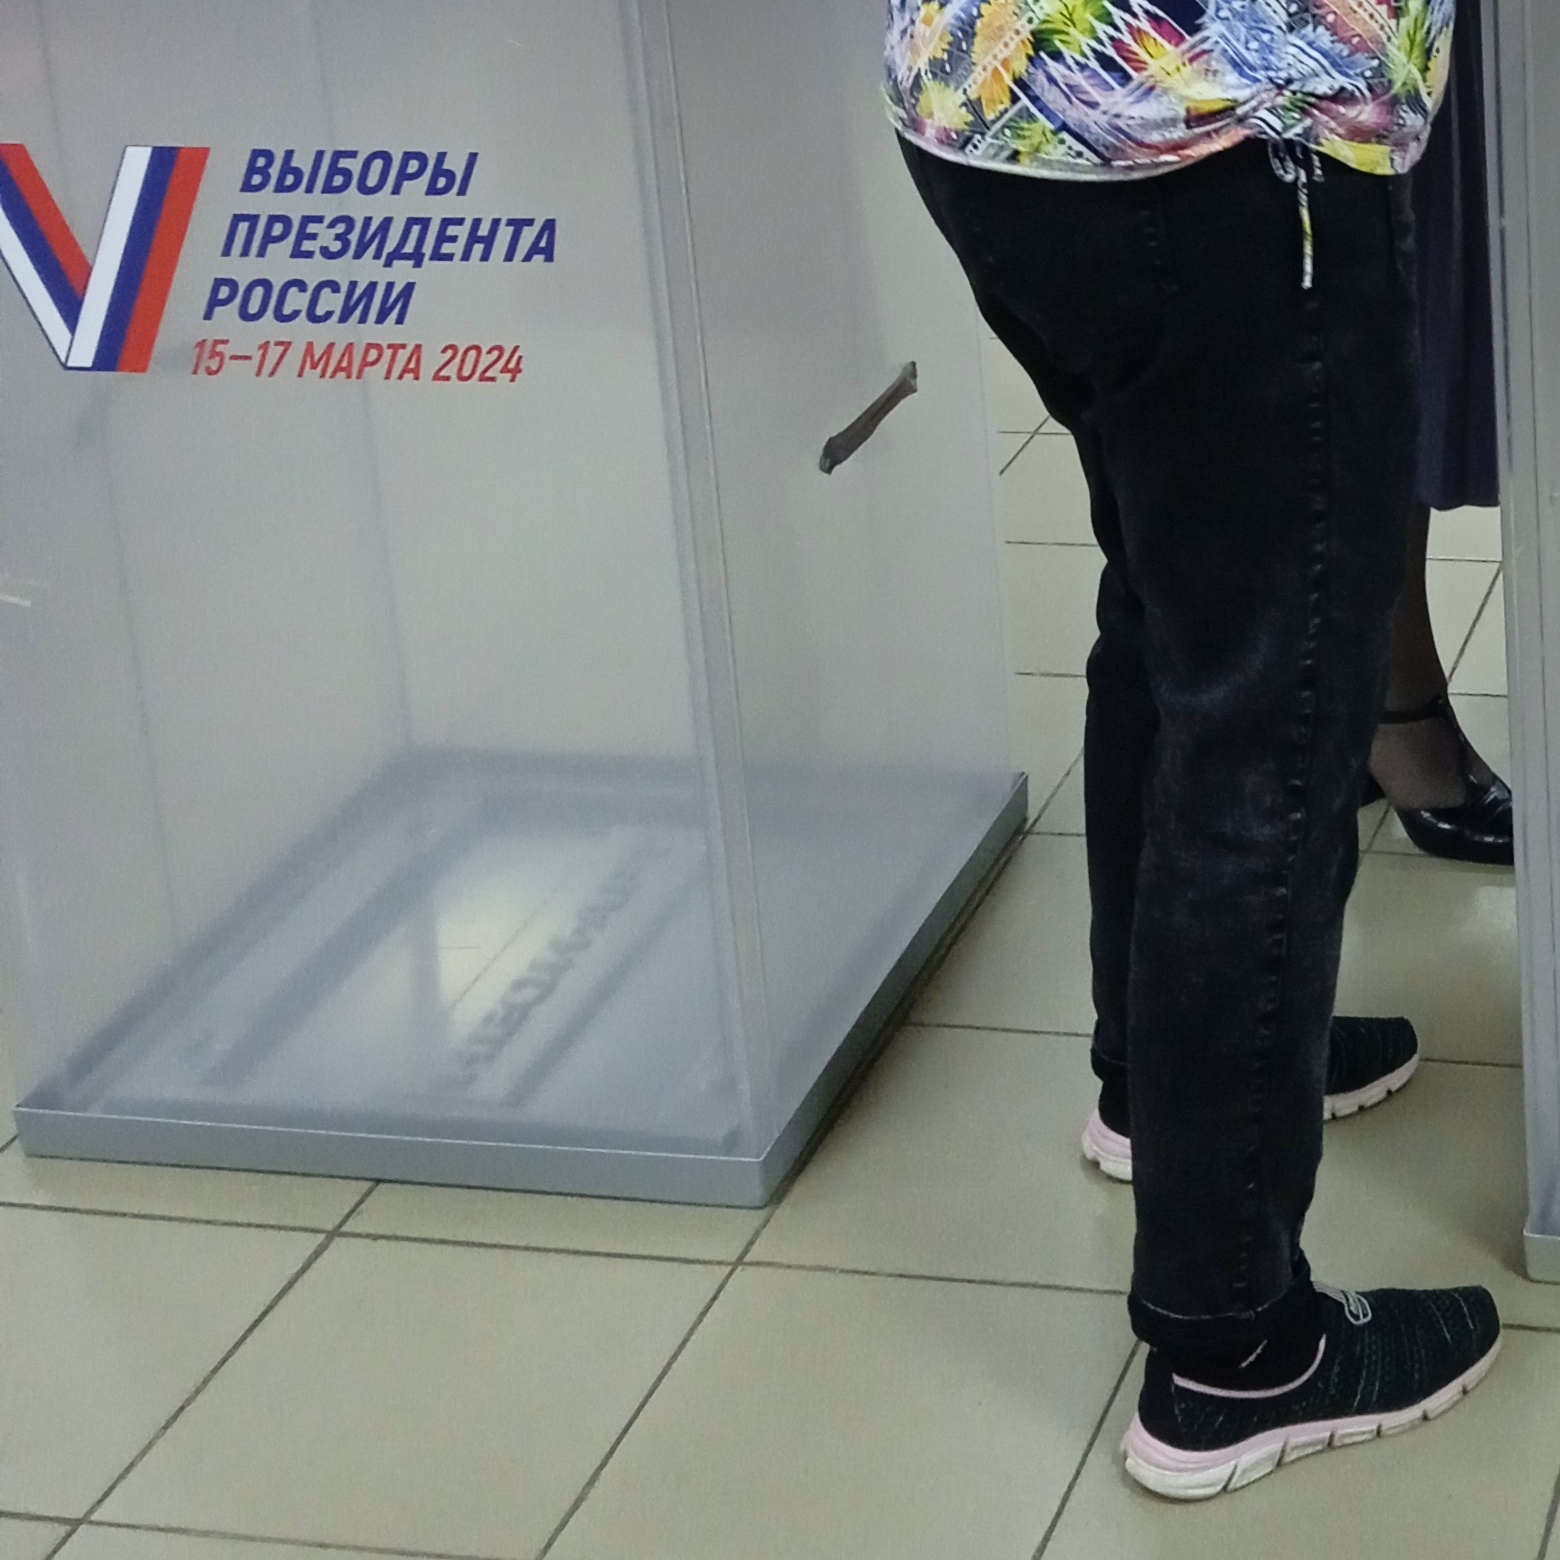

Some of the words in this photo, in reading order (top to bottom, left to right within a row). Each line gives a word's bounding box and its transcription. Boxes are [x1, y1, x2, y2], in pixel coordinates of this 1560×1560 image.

[239, 148, 480, 198] ВЫБОРЫ
[220, 213, 558, 269] ПРЕЗИДЕНТА
[202, 277, 416, 326] РОССИИ
[297, 341, 422, 382] МАРТА
[431, 343, 524, 384] 2024
